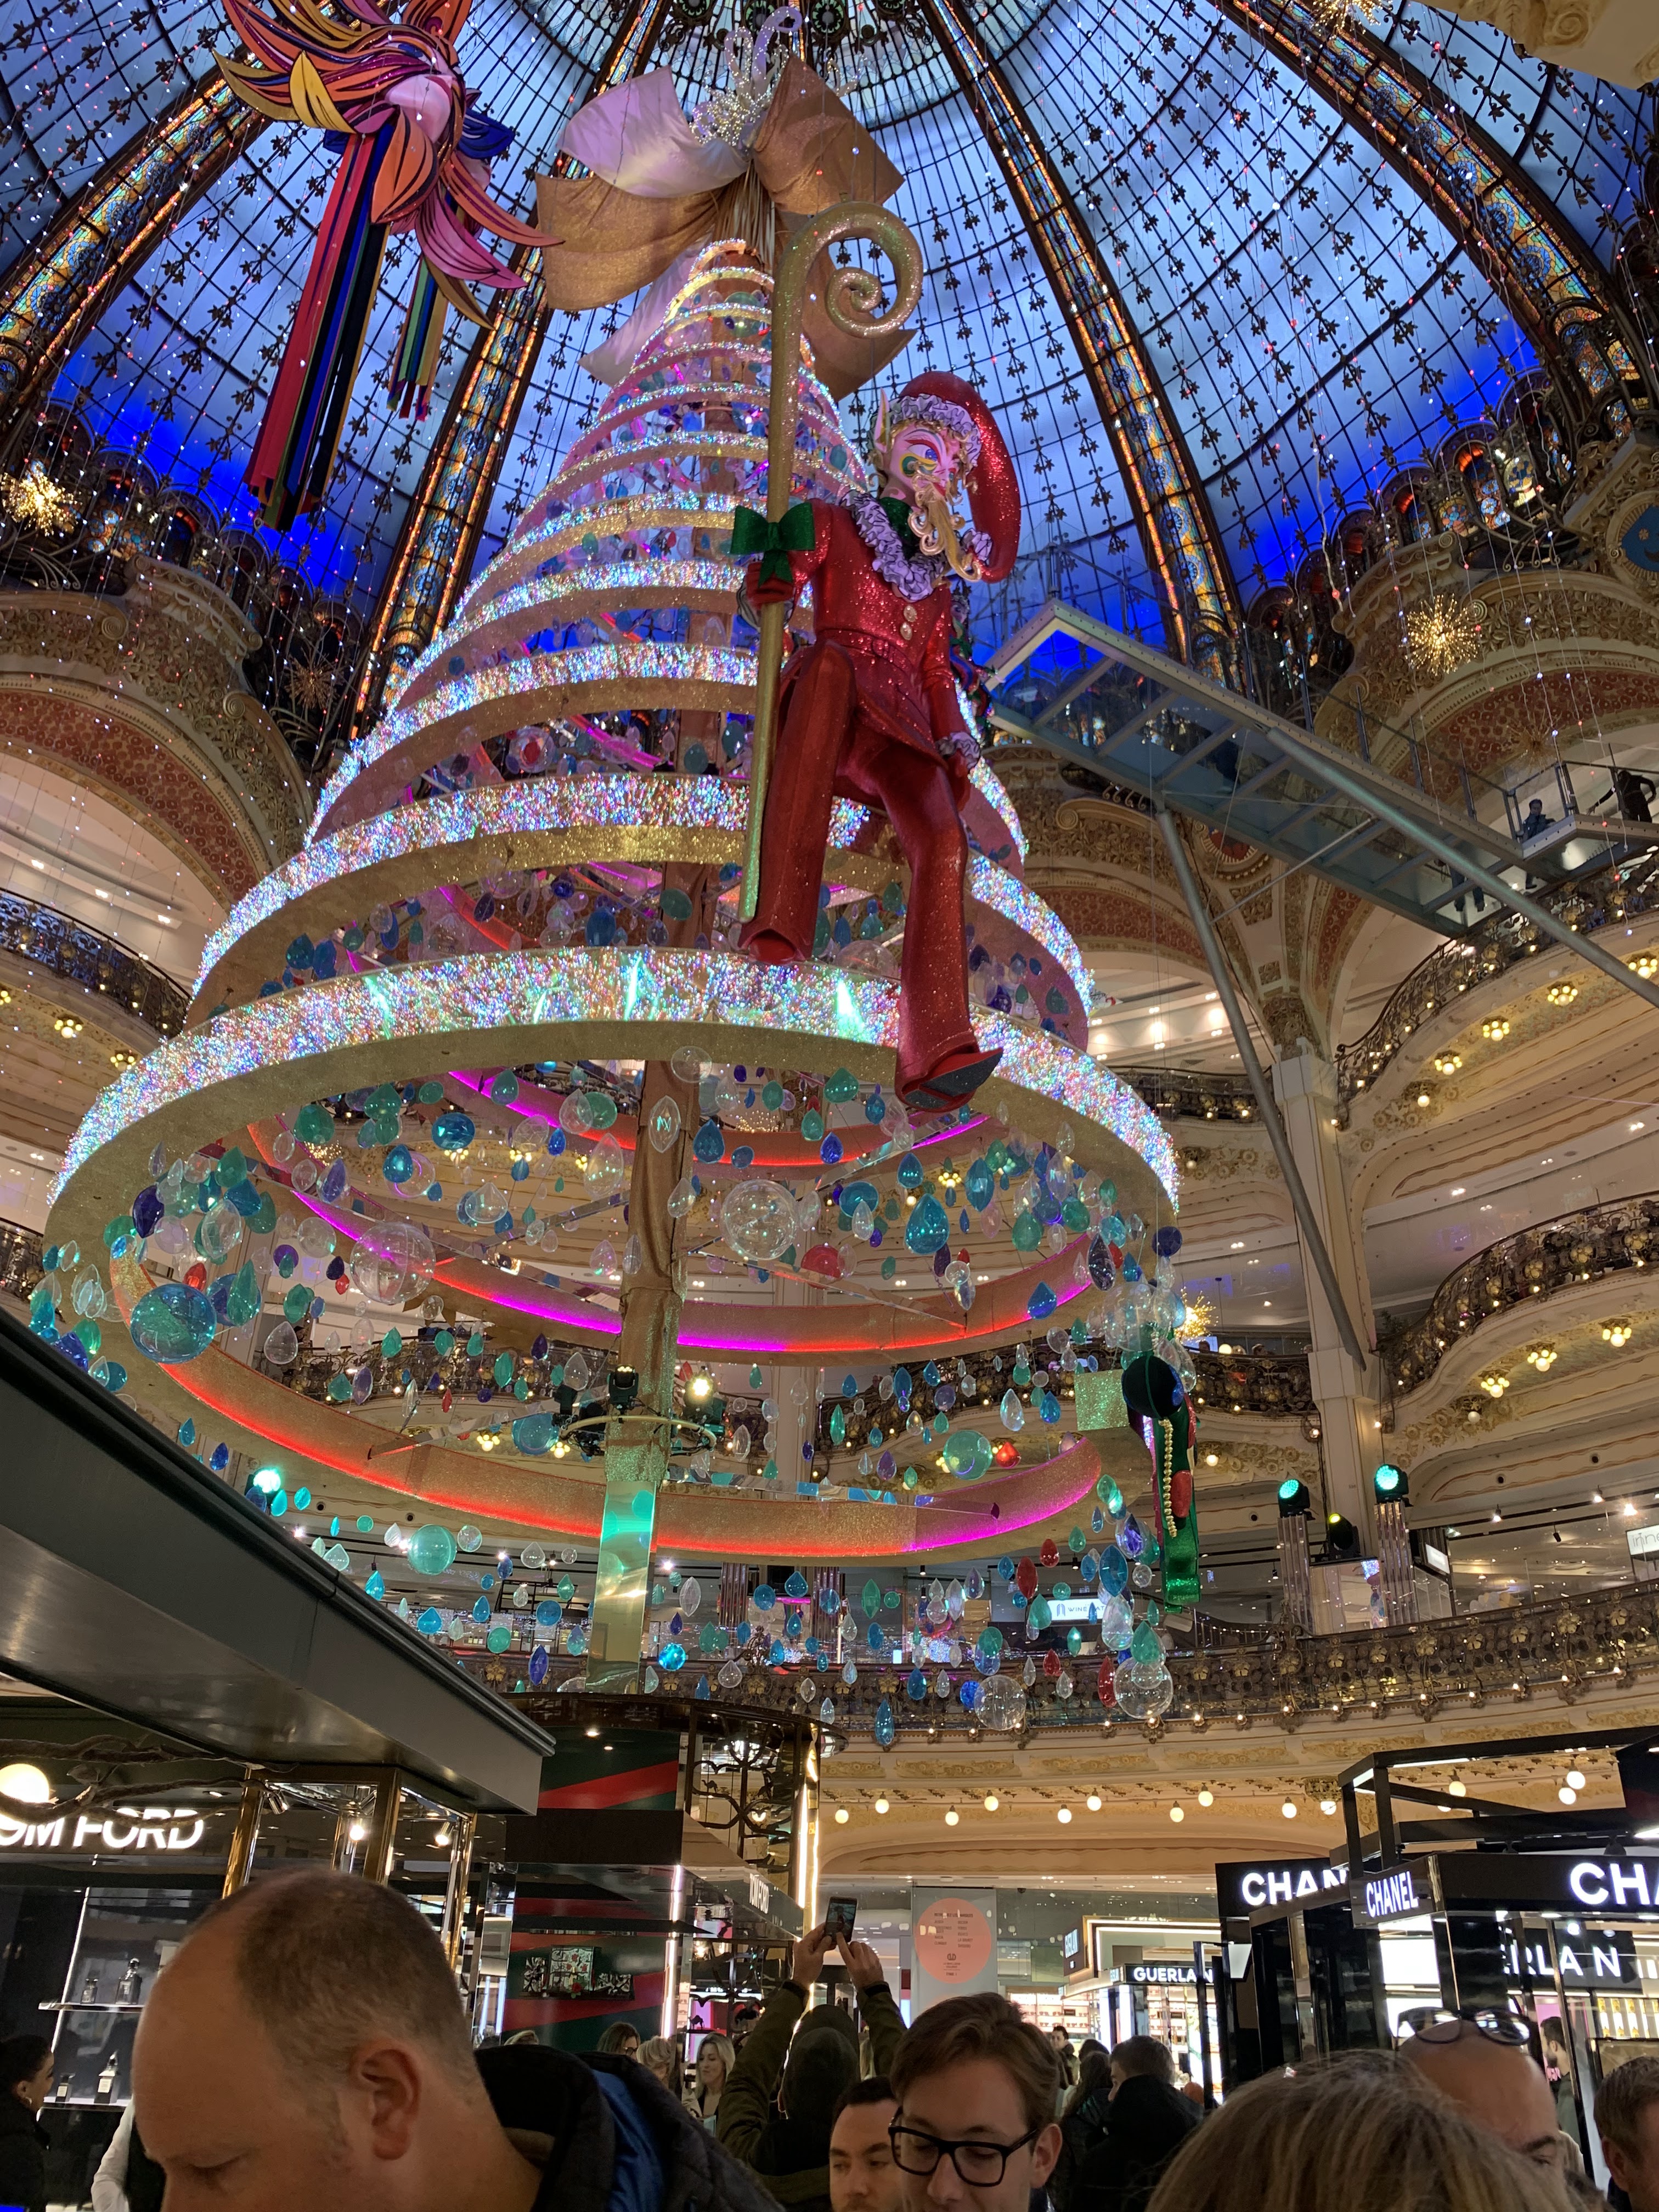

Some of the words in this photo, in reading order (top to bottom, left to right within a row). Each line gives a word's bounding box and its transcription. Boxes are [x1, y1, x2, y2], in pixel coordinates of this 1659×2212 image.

[1633, 1533, 1659, 1547] inn
[72, 1808, 204, 1849] FORD
[1366, 1871, 1419, 1918] CHANEL
[1570, 1862, 1659, 1905] CH
[1133, 1966, 1214, 1984] GUERLAN
[1500, 1944, 1621, 1977] RLAN
